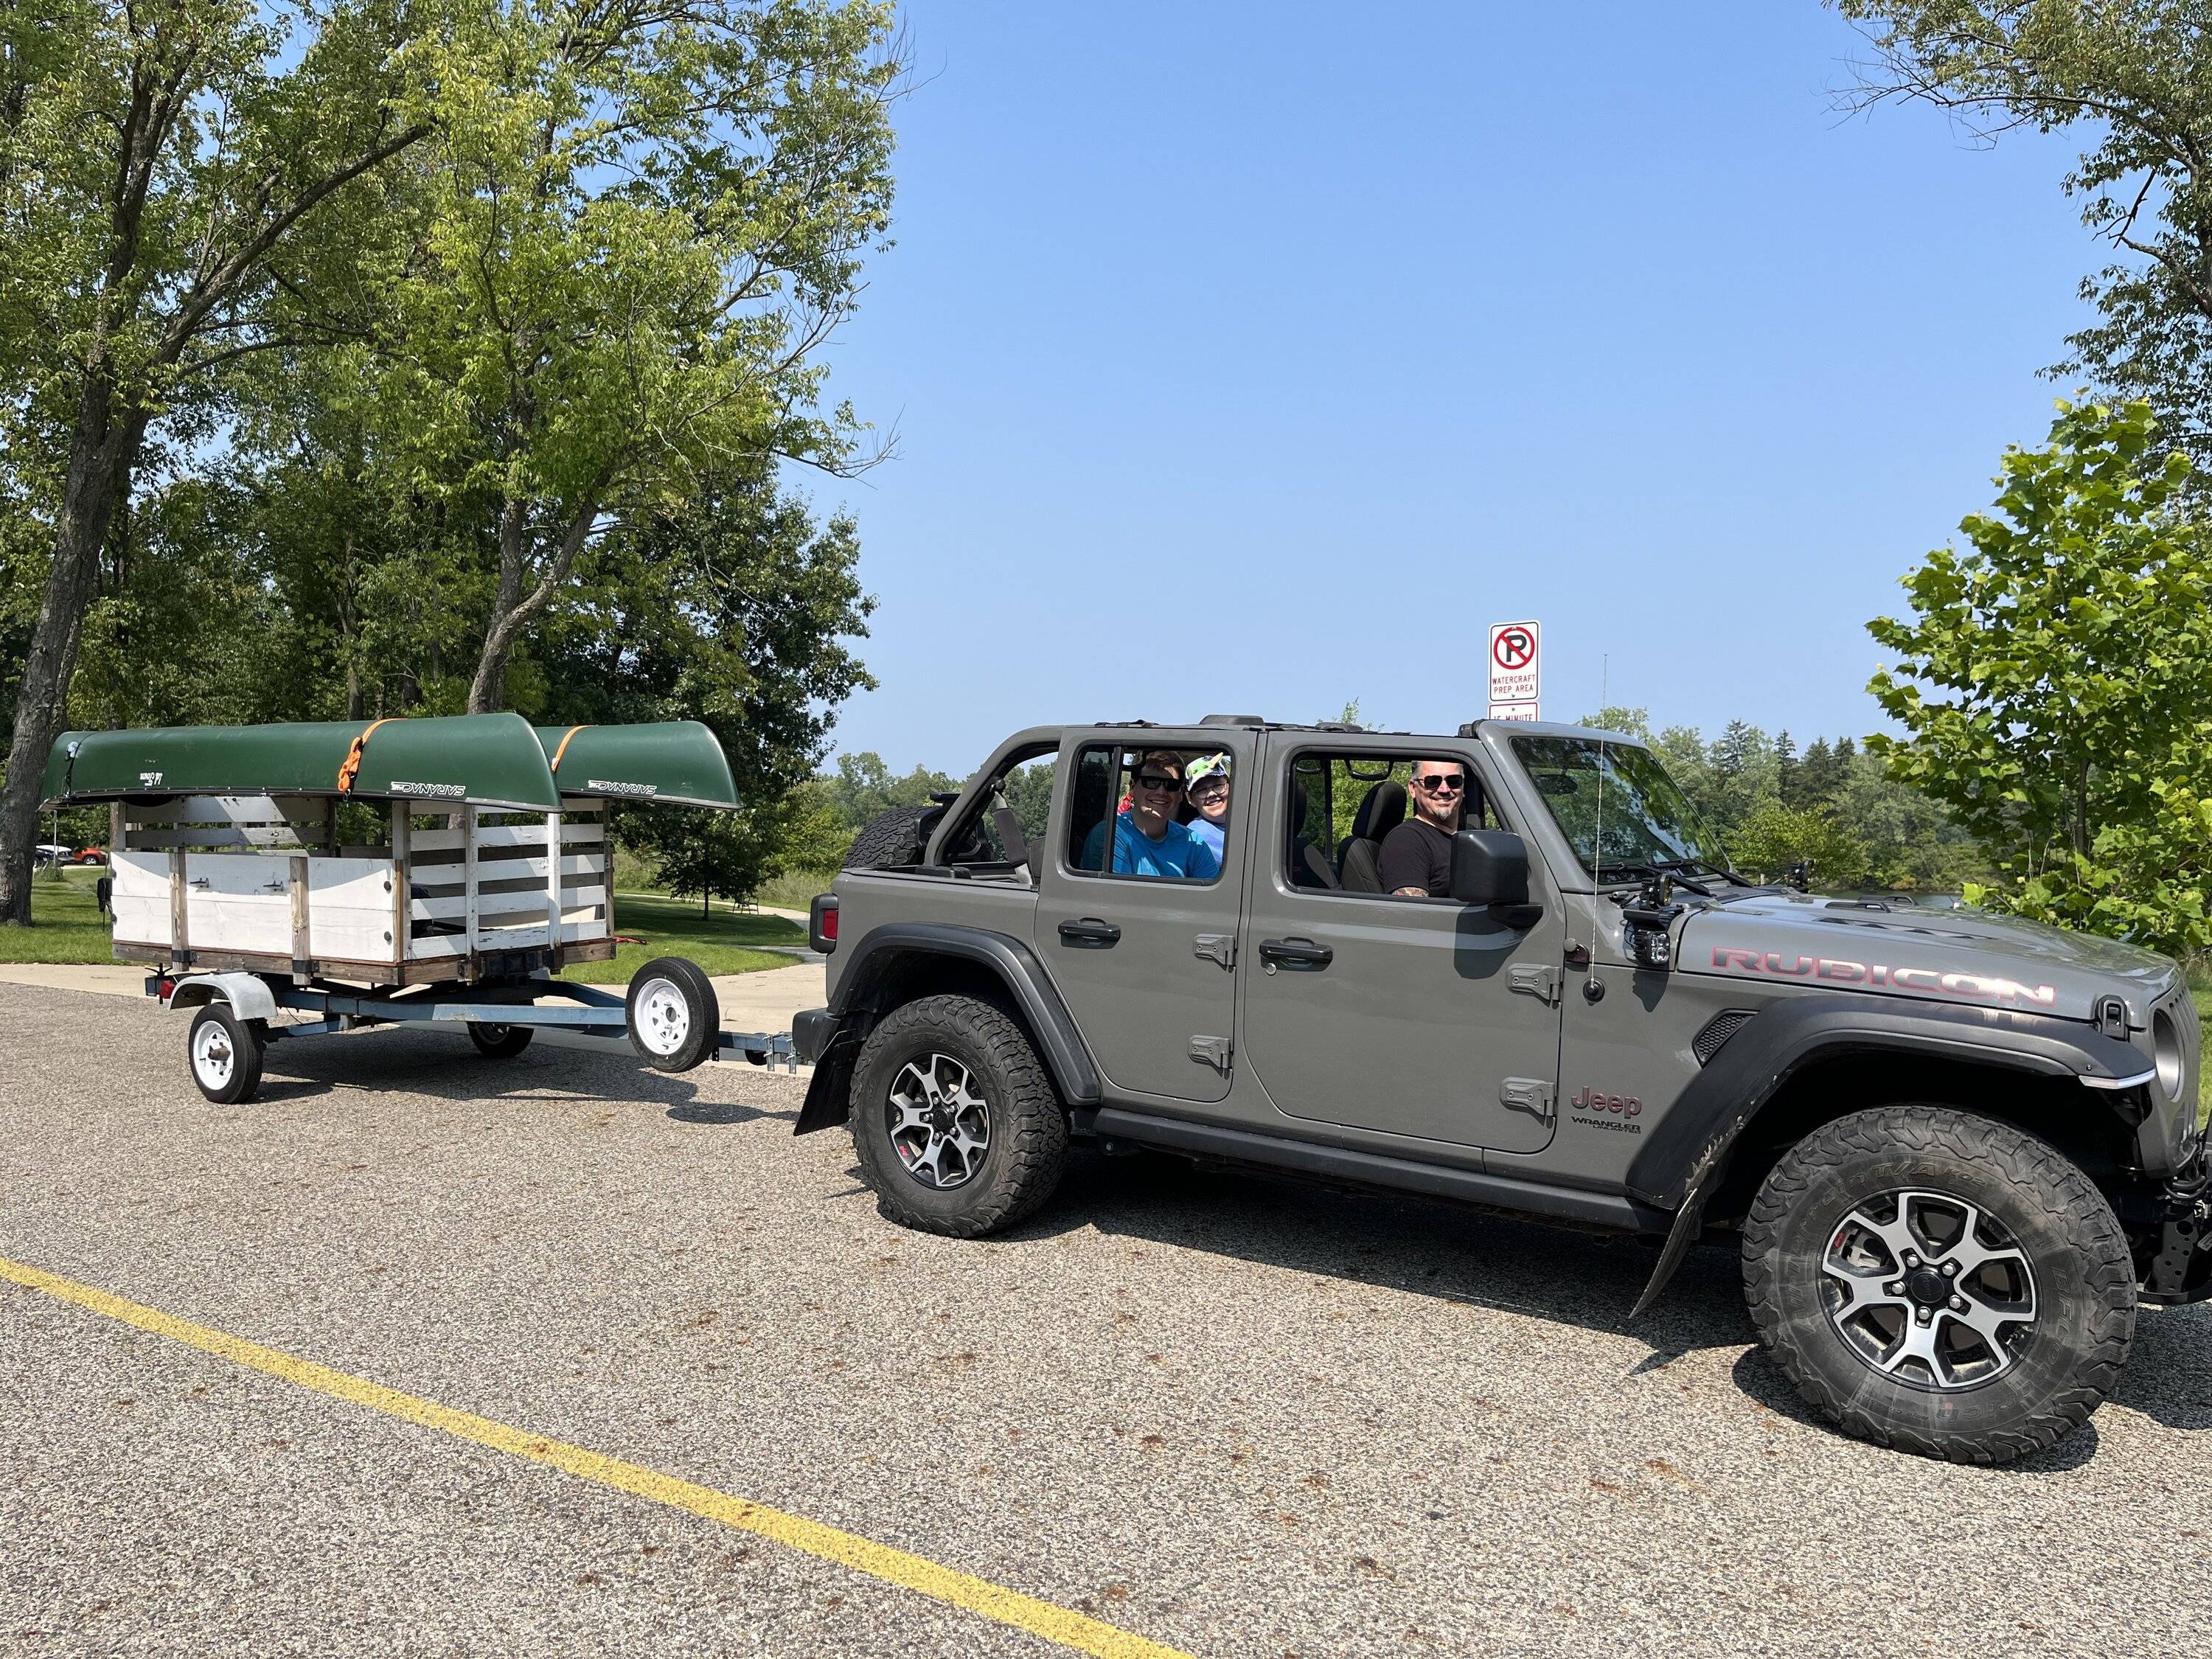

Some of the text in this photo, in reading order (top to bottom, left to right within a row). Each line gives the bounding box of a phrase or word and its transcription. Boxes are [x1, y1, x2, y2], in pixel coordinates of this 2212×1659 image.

[1492, 674, 1536, 685] WATERCRAFT
[1494, 684, 1534, 694] PREP AREA
[403, 782, 466, 796] SARANAC
[599, 781, 658, 795] SARANAC
[1711, 945, 2057, 1007] RUBICON
[1571, 1085, 1642, 1119] Jeep
[1571, 1116, 1641, 1130] WRANGLER
[1593, 1124, 1641, 1135] UNLIMITED
